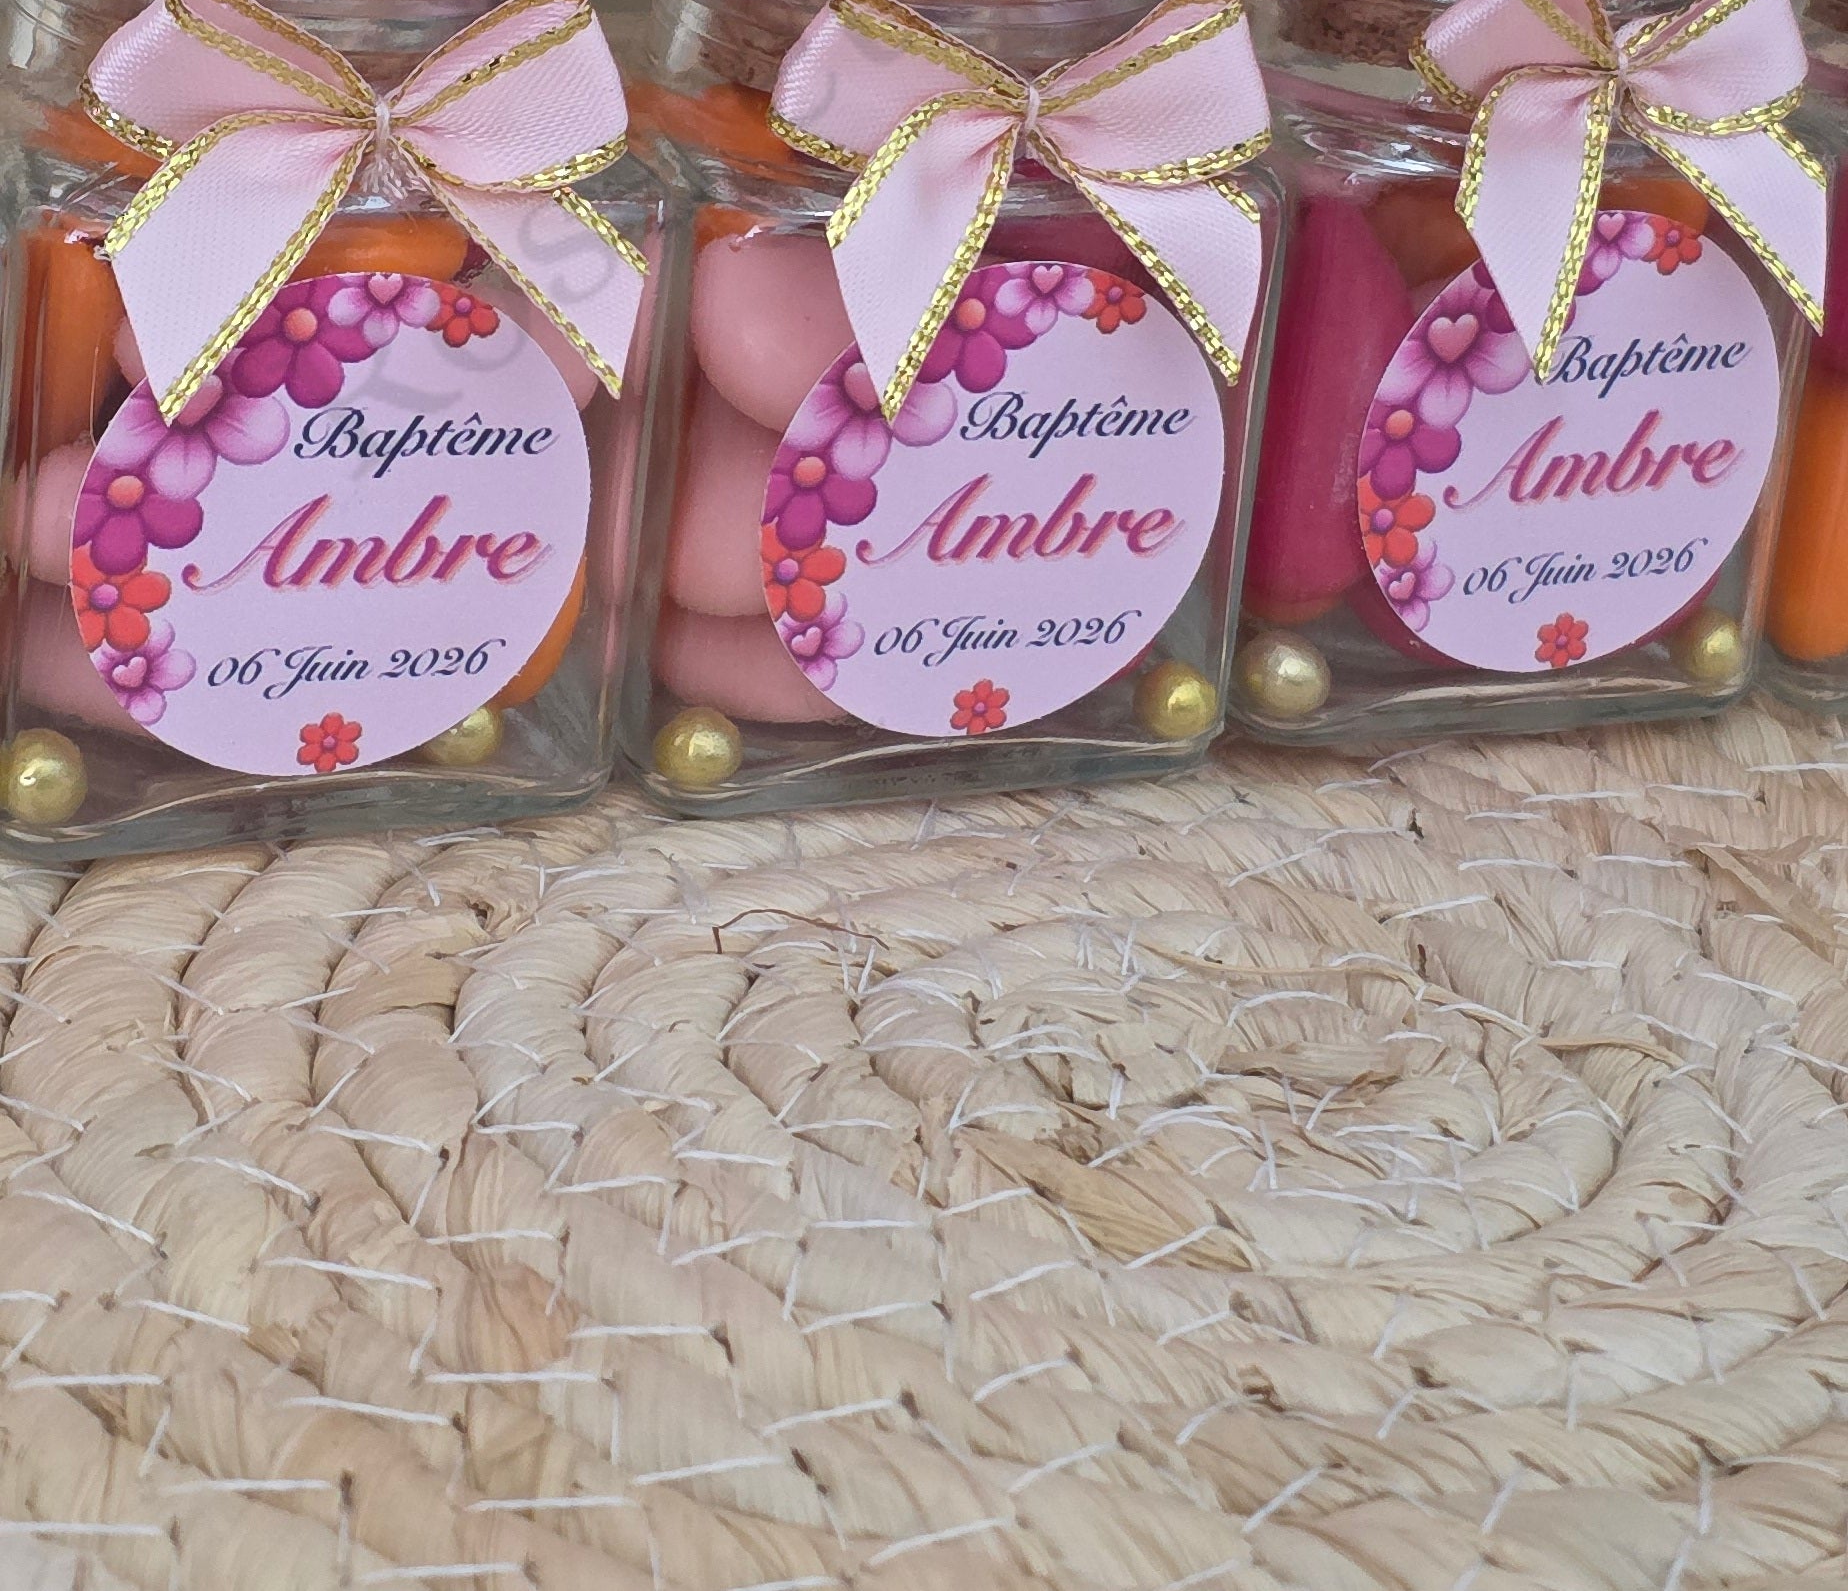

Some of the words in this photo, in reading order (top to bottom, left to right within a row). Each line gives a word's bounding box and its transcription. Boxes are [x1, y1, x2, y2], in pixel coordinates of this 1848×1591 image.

[1538, 332, 1755, 400] Baptême
[293, 406, 560, 480] Baptême
[959, 390, 1198, 459] Baptême
[1442, 408, 1745, 511] Ambre
[181, 493, 553, 593] Ambre
[855, 472, 1186, 567] Ambre
[1462, 556, 1523, 596] 06
[1507, 551, 1597, 605] Juin
[1601, 537, 1709, 580] 2026
[207, 646, 282, 688] 06
[263, 644, 373, 701] Juin
[377, 638, 507, 679] 2026
[873, 617, 941, 656] 06
[921, 614, 1021, 668] Juin
[1025, 609, 1143, 648] 2026
